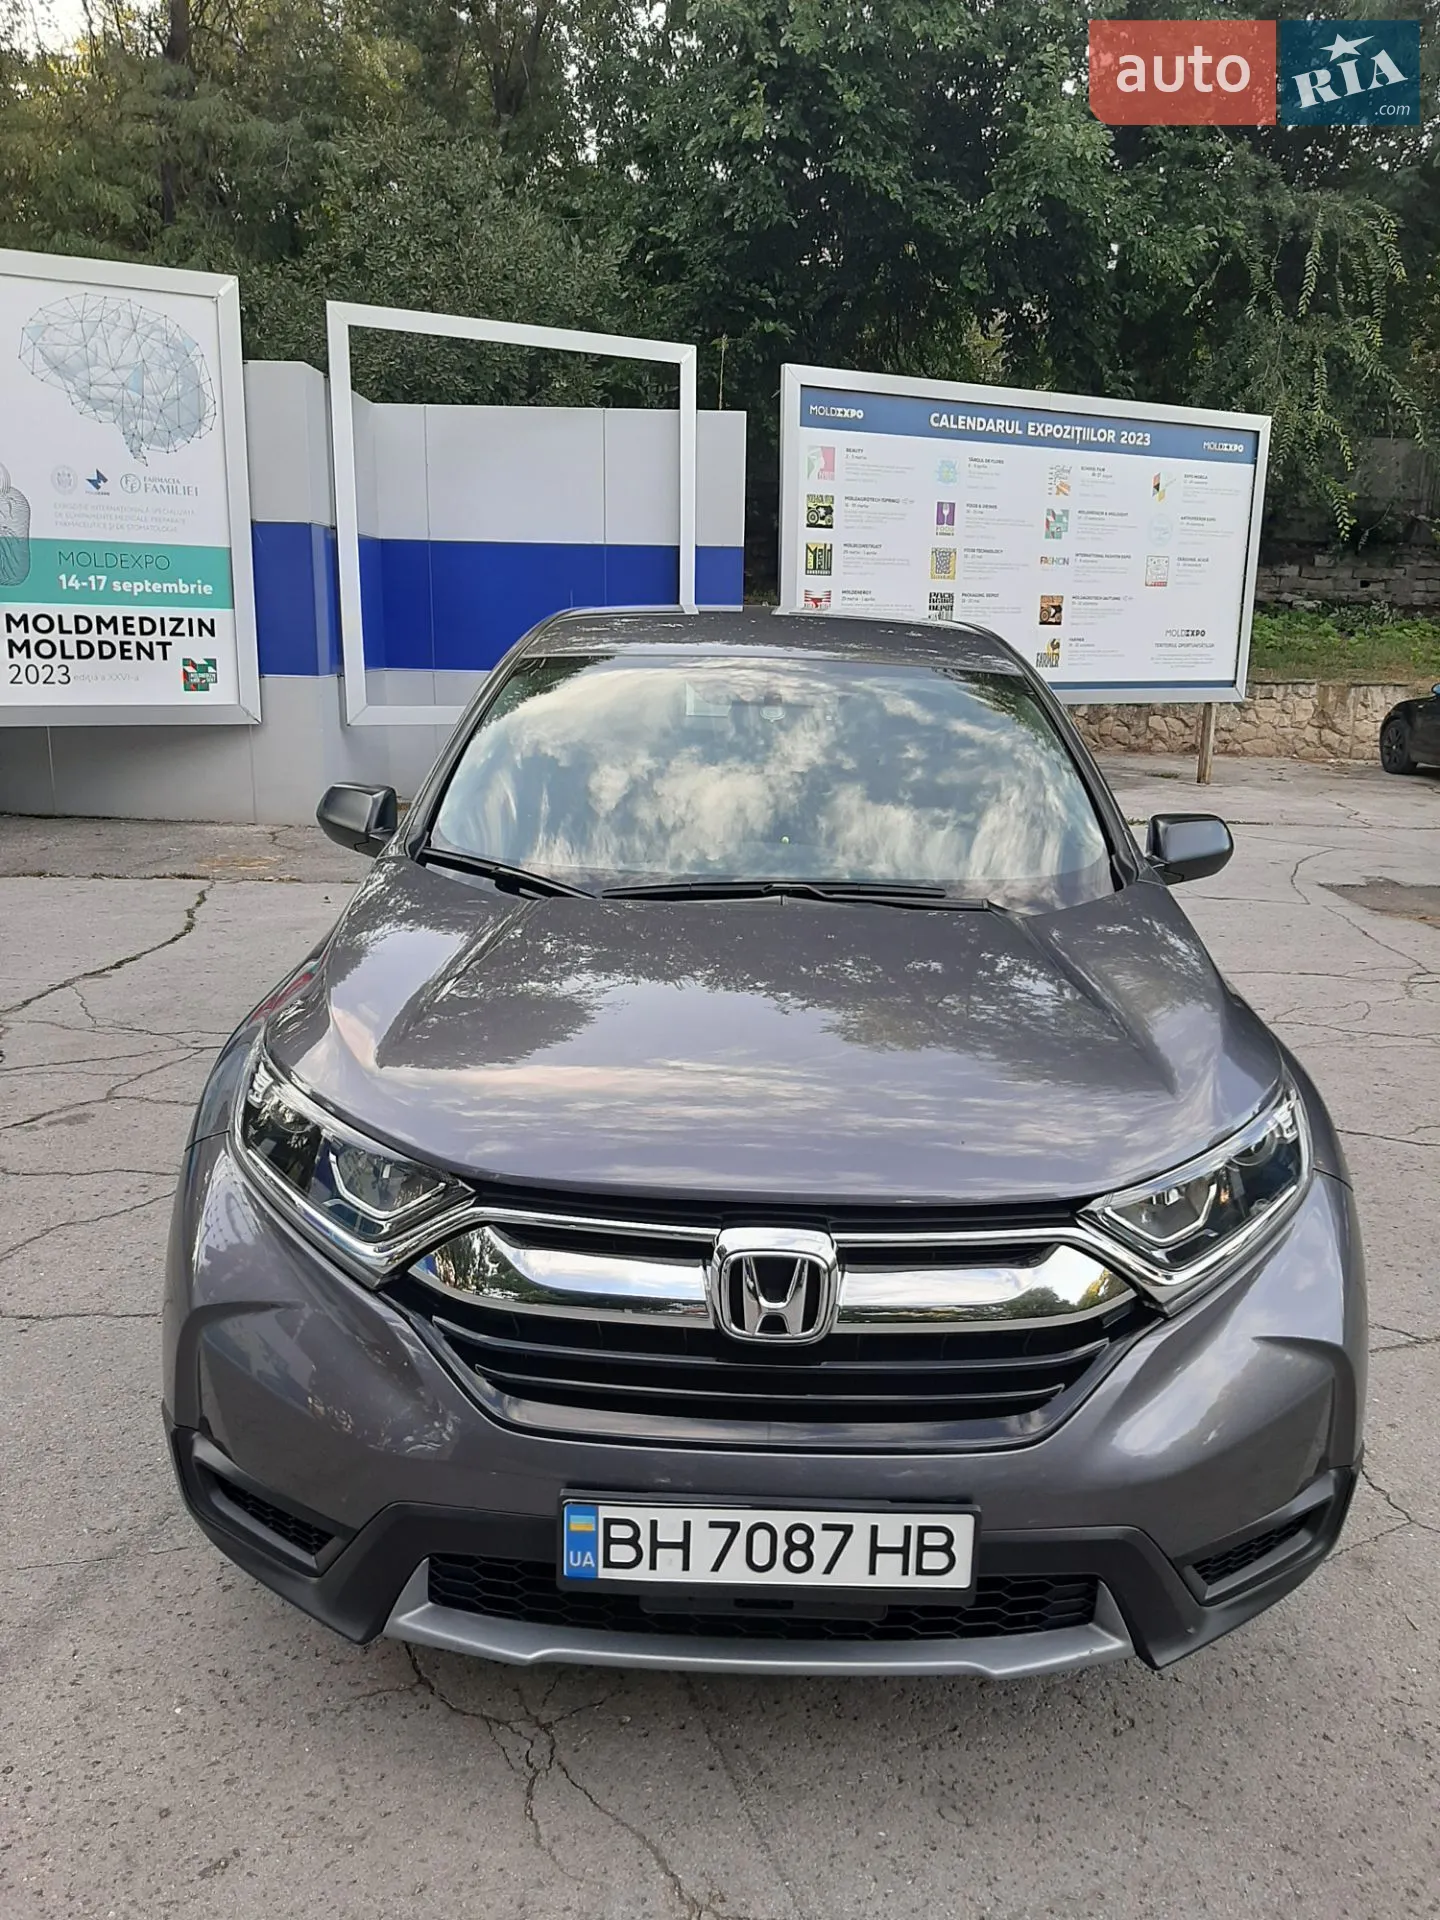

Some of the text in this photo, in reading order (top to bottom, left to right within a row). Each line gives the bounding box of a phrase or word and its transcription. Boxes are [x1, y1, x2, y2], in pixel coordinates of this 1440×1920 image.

[809, 405, 864, 419] MOLDEXPO
[929, 412, 1151, 446] CALENDARUL EXPOZIȚIILOR 2023
[1203, 441, 1244, 453] MOLDEXPO
[143, 476, 181, 485] FARMACIA
[143, 483, 199, 497] FAMILIEI
[58, 551, 171, 571] MOLDEXPO
[58, 573, 213, 596] 14-17 septembrie
[4, 612, 216, 638] MOLDMEDIZIN
[1165, 629, 1206, 637] MOLDEXPO
[6, 638, 173, 661] MOLDDENT
[8, 664, 72, 685] 2023
[569, 1516, 957, 1577] UA BH 7087 HB
